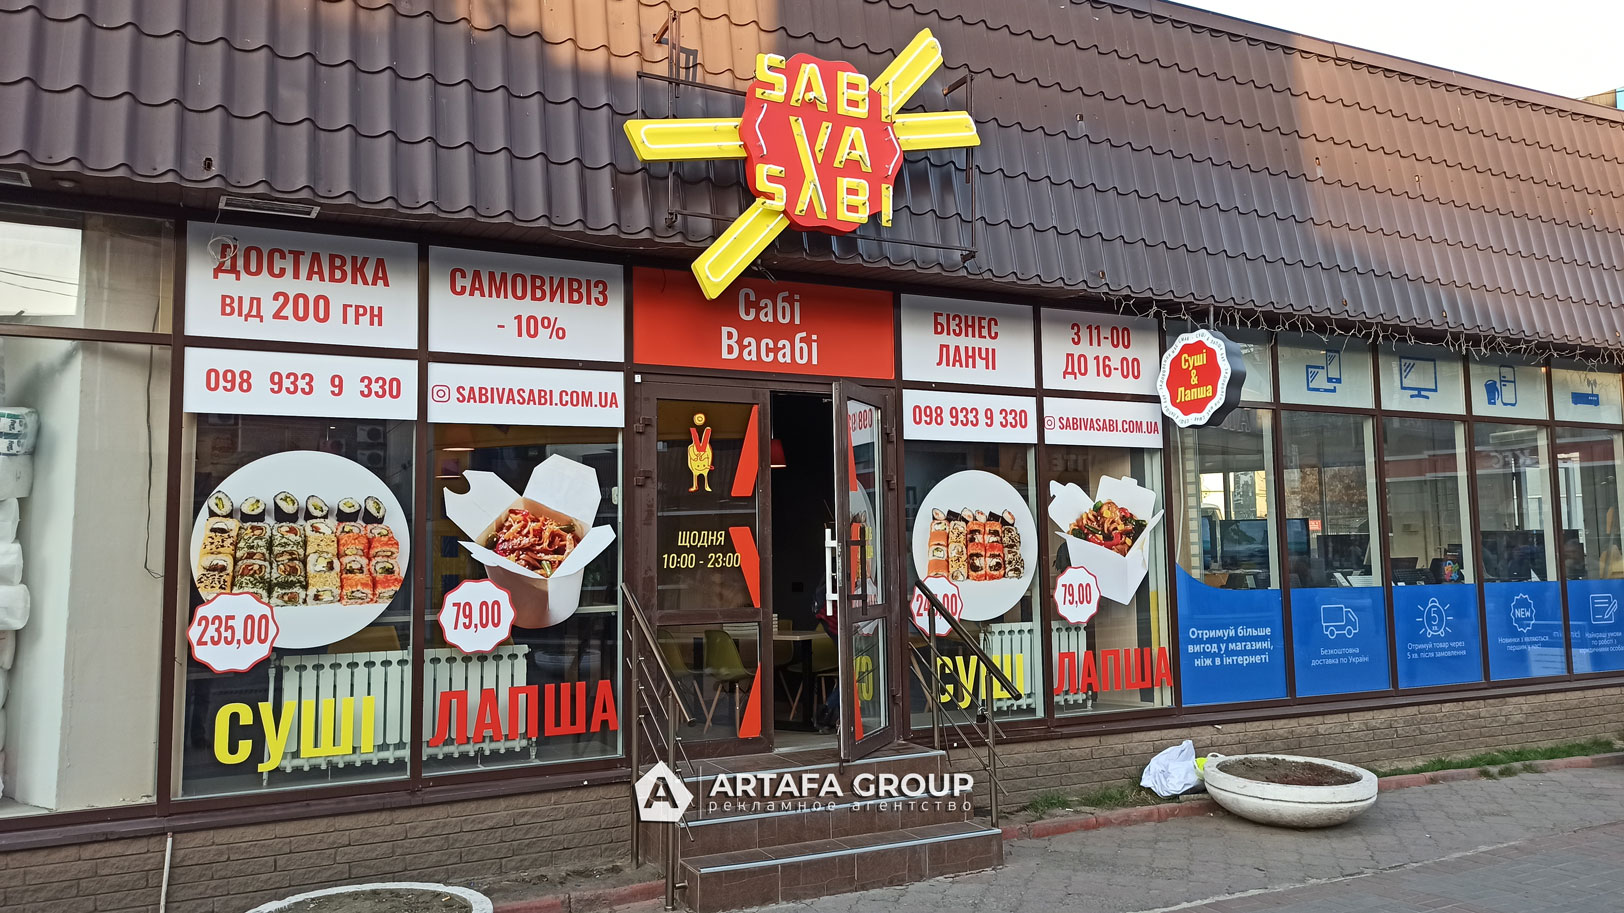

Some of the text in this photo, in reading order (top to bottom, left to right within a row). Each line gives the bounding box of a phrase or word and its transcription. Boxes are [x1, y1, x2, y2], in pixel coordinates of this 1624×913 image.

[213, 243, 390, 288] ДОСТАВКА
[448, 267, 609, 307] САМОВИВІЗ
[219, 291, 384, 328] ВІД 200 ГРН
[738, 287, 801, 325] Сабі
[513, 314, 567, 341] 10%
[932, 311, 1000, 341] БІЗНЕС
[1086, 325, 1132, 350] 11-00
[721, 326, 818, 365] Васабі
[935, 343, 998, 371] ЛАНЧІ
[1062, 353, 1142, 380] ДО 16-00
[1181, 349, 1207, 371] Суші
[205, 367, 402, 400] 098 933 9 330
[1190, 369, 1199, 385] &
[456, 384, 620, 410] SABIVASABI.COM.UA
[1176, 384, 1213, 403] Лапша
[912, 404, 1029, 430] 098 933 9 330
[1058, 416, 1160, 436] SABIVASABI.COM.UA
[677, 530, 726, 548] ЩОДНЯ
[662, 552, 696, 569] 10:00
[707, 552, 741, 568] 23:00
[1061, 582, 1093, 609] 79,00
[452, 598, 502, 632] 79,00
[1431, 607, 1439, 624] 5
[1515, 608, 1531, 618] NEW
[195, 613, 270, 650] 235,00
[1189, 625, 1271, 641] Отримуй більше
[1188, 643, 1218, 653] вигод
[1228, 638, 1273, 651] магазині,
[1320, 647, 1360, 655] Безкоштовна
[1407, 641, 1433, 651] Отримуй
[1053, 646, 1173, 696] ЛАПША
[1194, 652, 1269, 667] ніж в інтернеті
[1311, 658, 1339, 666] доставка
[428, 679, 620, 748] ЛАПША
